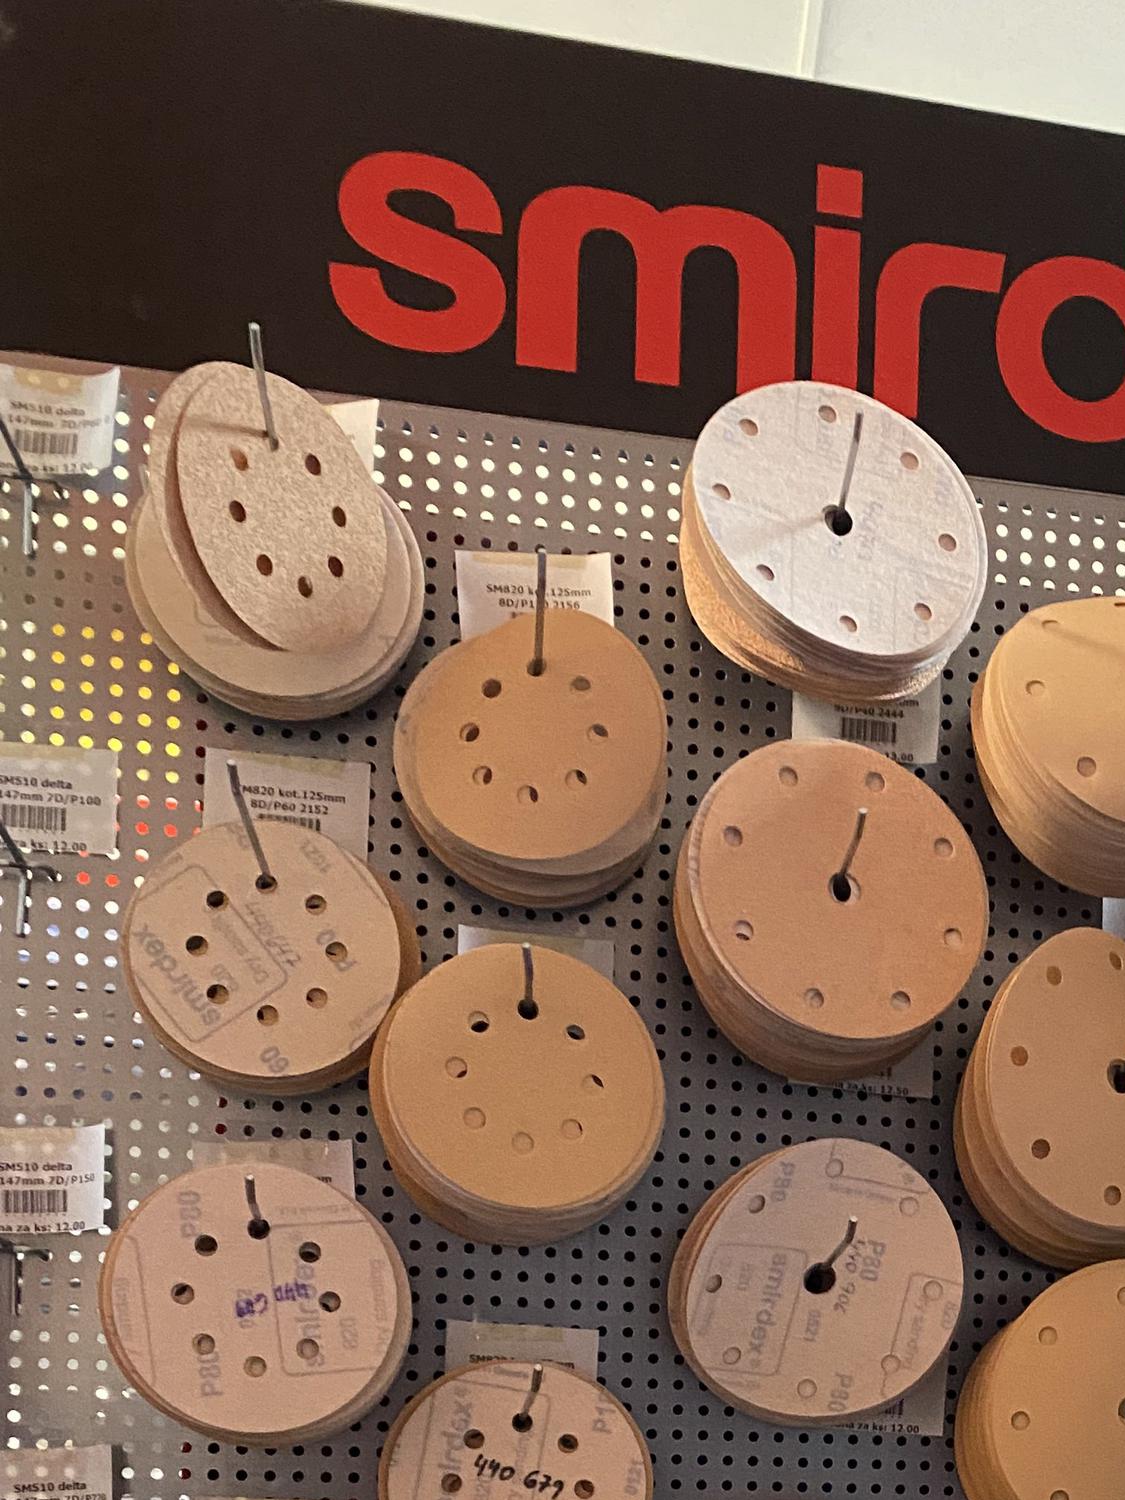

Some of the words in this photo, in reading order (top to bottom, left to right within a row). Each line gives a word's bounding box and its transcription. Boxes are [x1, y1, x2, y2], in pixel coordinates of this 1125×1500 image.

[487, 584, 524, 594] SM820
[499, 598, 549, 609] 8D/P10
[41, 780, 73, 790] delta
[241, 785, 275, 797] M820
[278, 789, 346, 803] kot.125mm
[251, 800, 296, 811] 8D/P60
[300, 802, 329, 815] 2152
[42, 1162, 73, 1171] delta
[34, 1222, 51, 1232] ks:
[861, 1239, 887, 1282] P80
[474, 1453, 515, 1481] 440
[58, 1481, 87, 1491] delta
